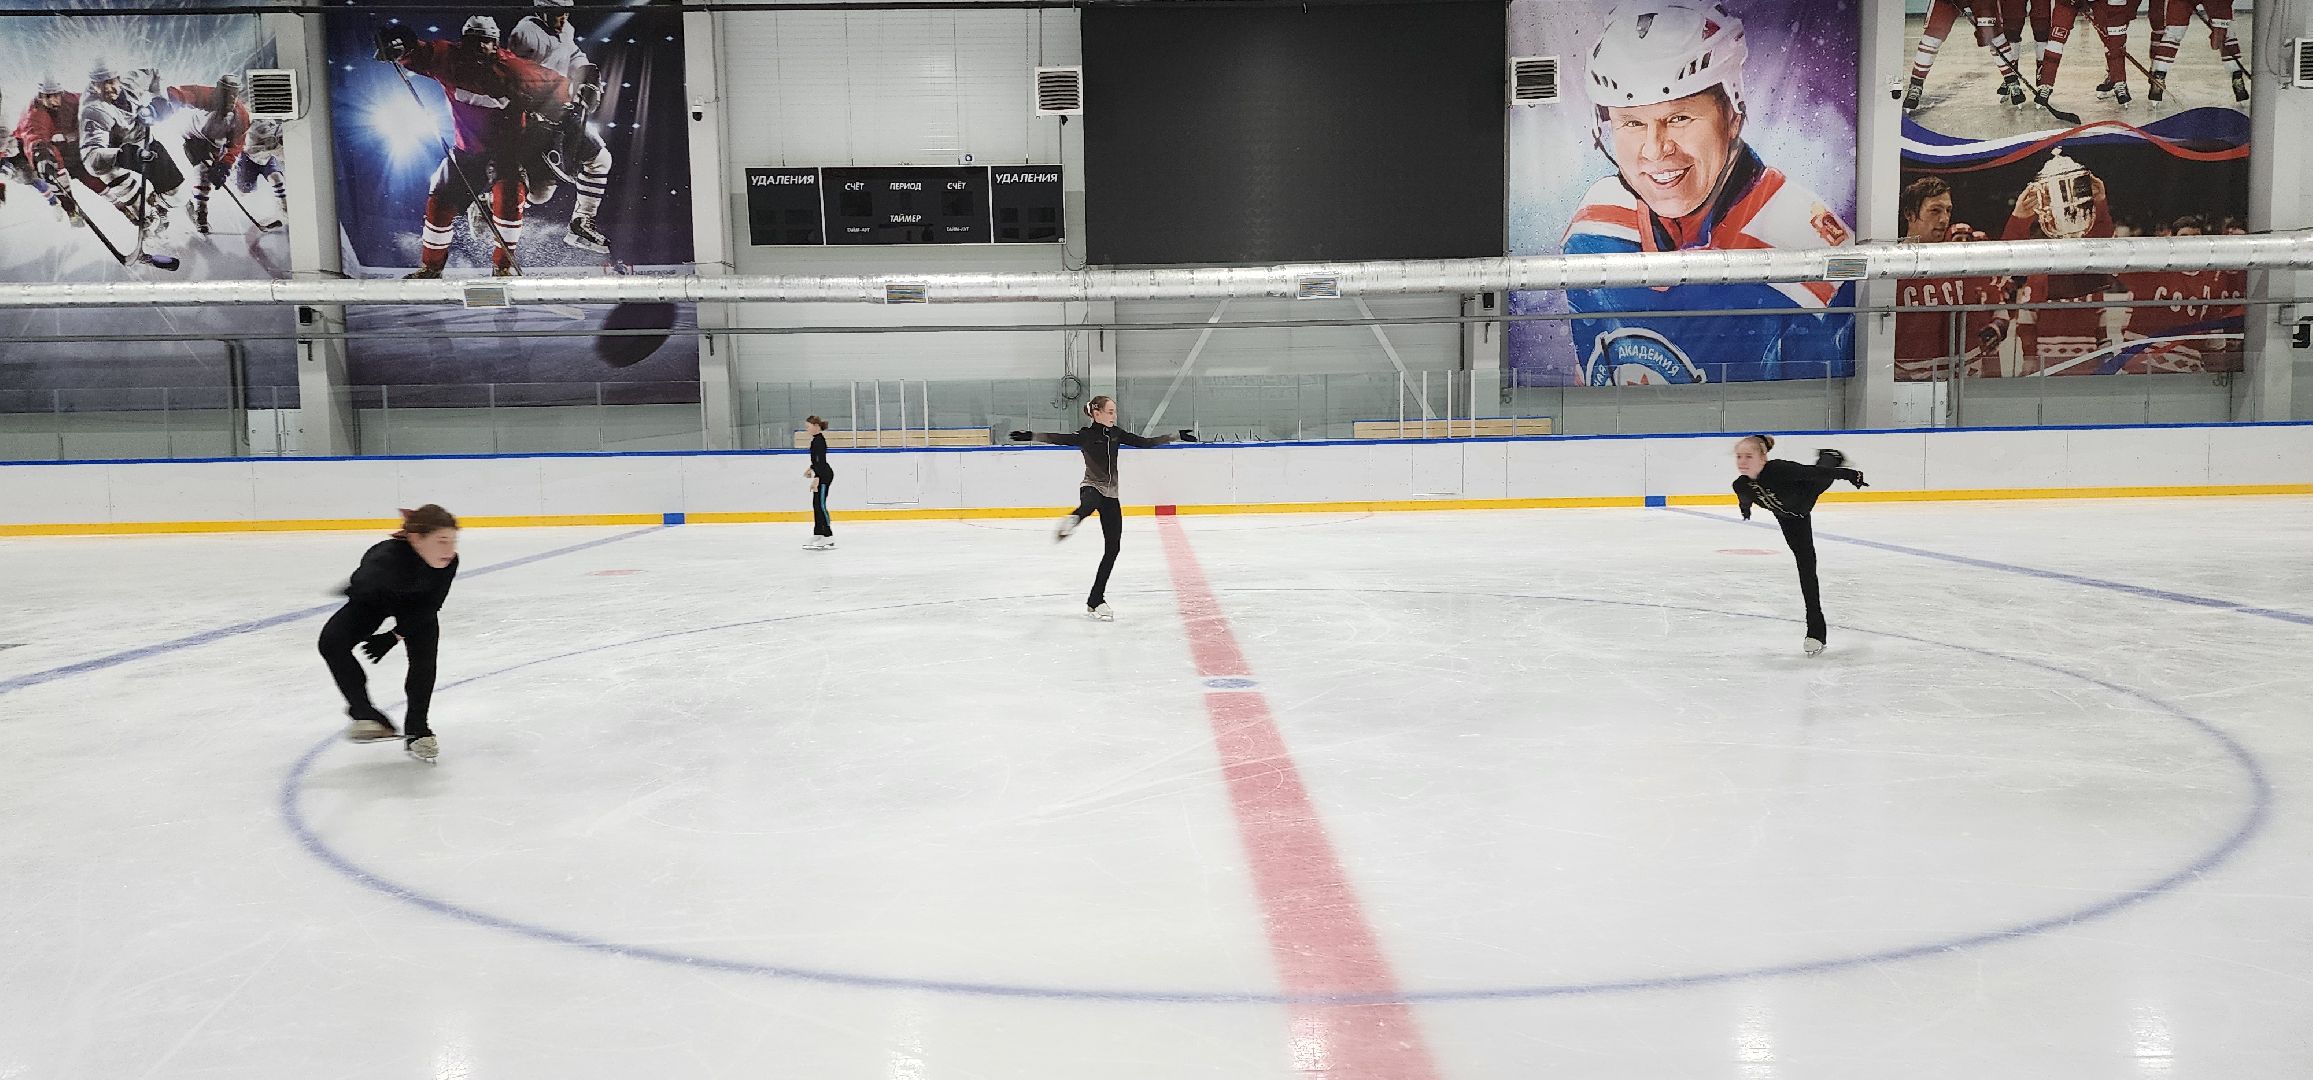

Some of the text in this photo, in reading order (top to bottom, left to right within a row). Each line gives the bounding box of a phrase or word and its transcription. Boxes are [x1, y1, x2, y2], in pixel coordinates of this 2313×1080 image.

[751, 174, 815, 186] УДАЛЕНИЯ
[995, 172, 1058, 184] УДАЛЕНИЯ
[844, 181, 865, 191] СЧЁТ
[889, 182, 922, 191] ПЕРИОД
[946, 181, 967, 190] СЧЁТ
[890, 213, 922, 223] ТАЙМЕР
[1618, 344, 1681, 377] АКАДЕМИЯ
